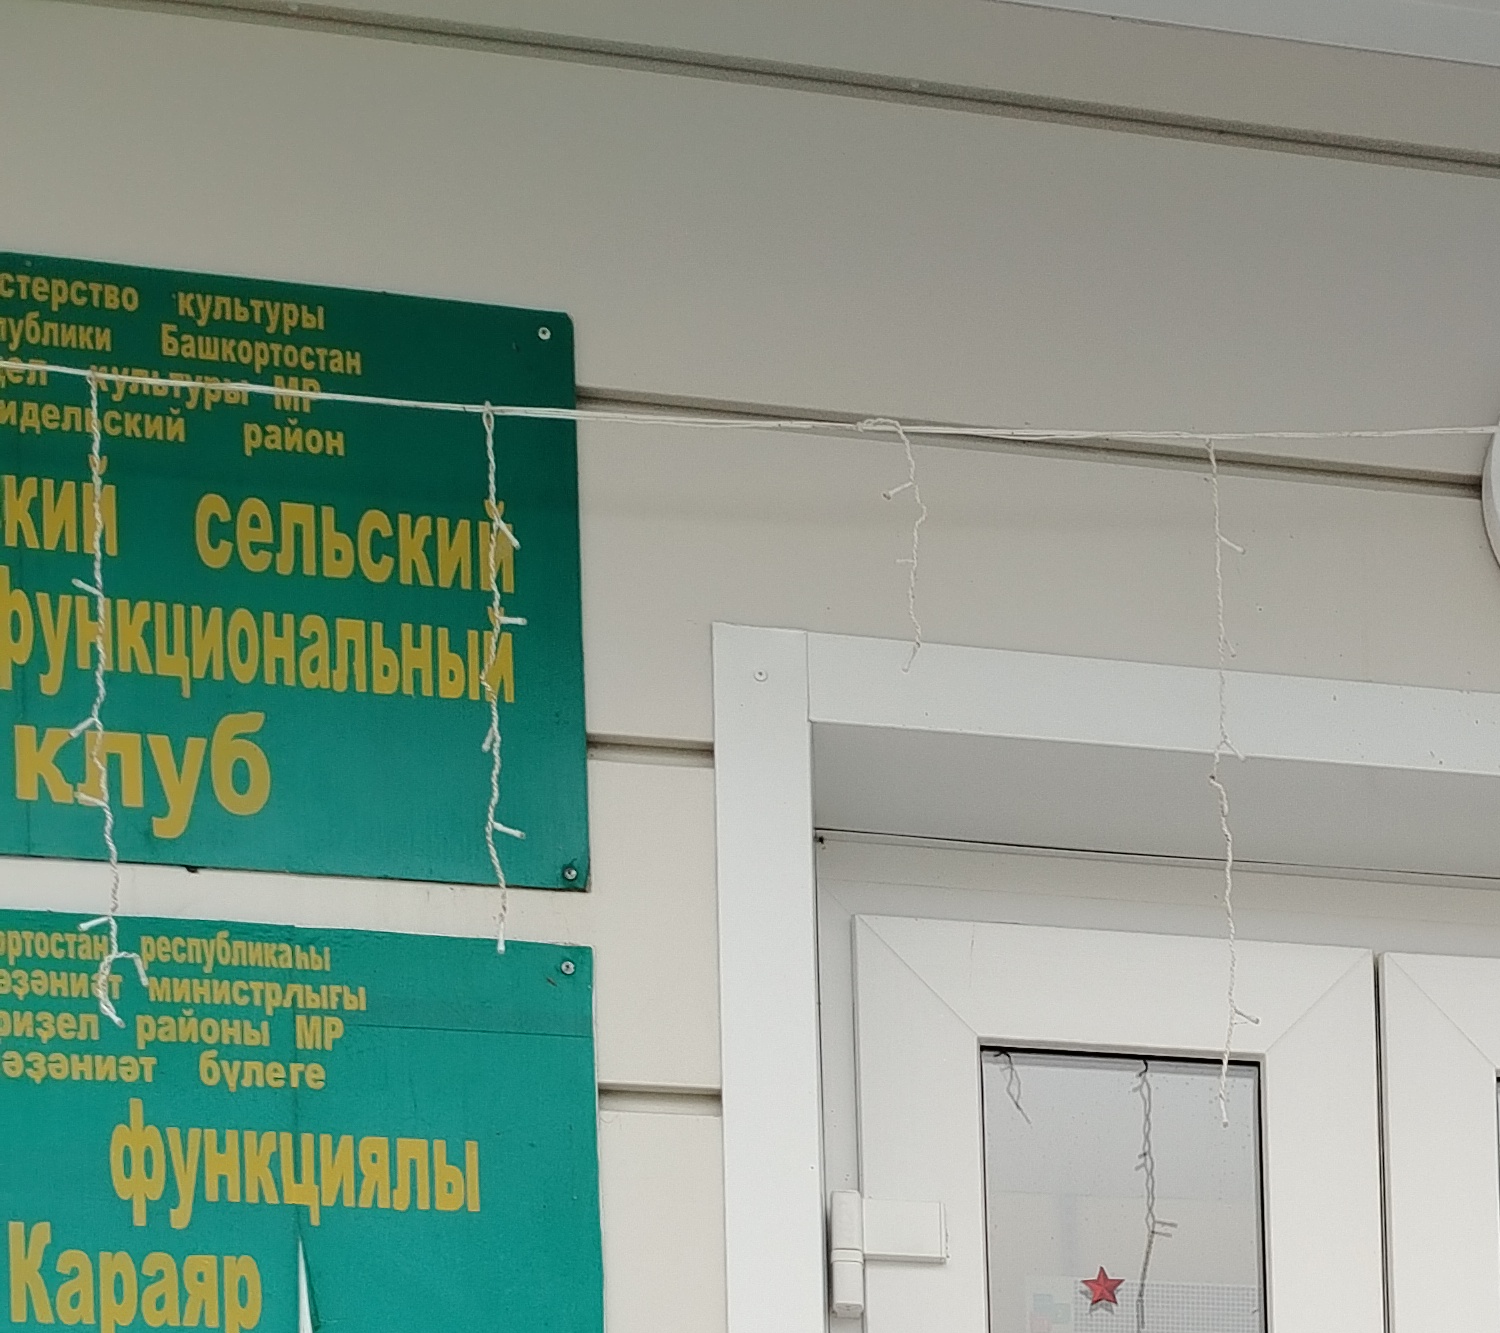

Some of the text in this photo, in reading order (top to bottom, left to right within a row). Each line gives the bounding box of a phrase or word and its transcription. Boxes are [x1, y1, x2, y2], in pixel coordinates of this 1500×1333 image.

[0, 273, 325, 335] стерство культуры
[161, 323, 362, 376] Башкортостан
[0, 355, 321, 413] ел культуры МР
[244, 416, 345, 456] район
[195, 493, 515, 594] сельский
[13, 711, 271, 839] клуб
[140, 930, 331, 974] республикаһы
[149, 976, 367, 1016] министрлығы
[136, 1008, 270, 1050] районы
[296, 1014, 345, 1051] МР
[3, 1050, 326, 1092] әҙәниәт бүлеге
[110, 1097, 481, 1229] функциялы
